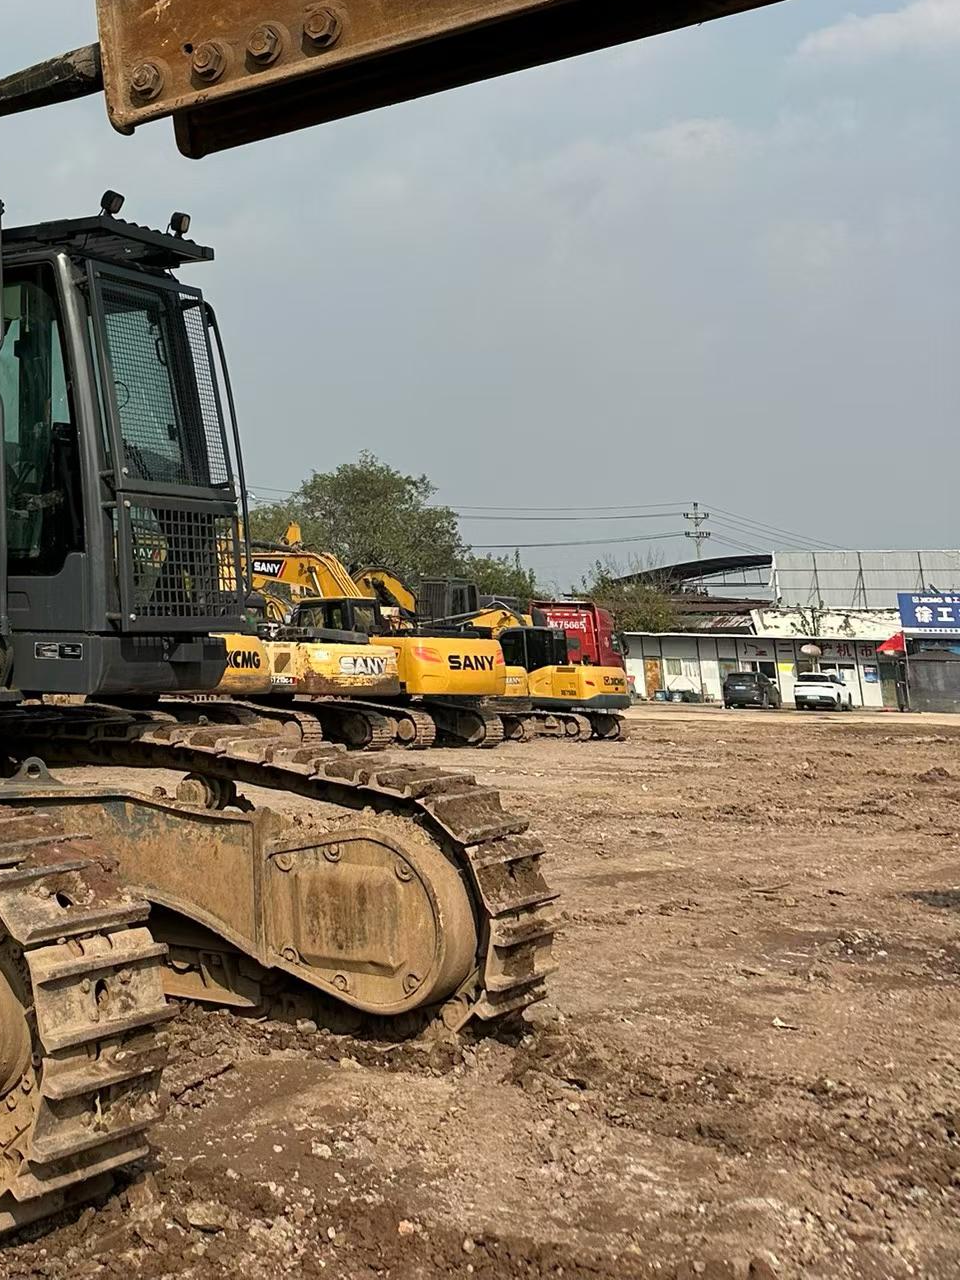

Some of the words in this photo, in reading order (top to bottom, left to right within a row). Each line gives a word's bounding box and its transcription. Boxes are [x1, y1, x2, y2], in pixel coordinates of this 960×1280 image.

[253, 561, 280, 574] SANY
[914, 606, 960, 623] 徐工
[339, 656, 387, 675] SANY
[448, 655, 494, 671] SANY
